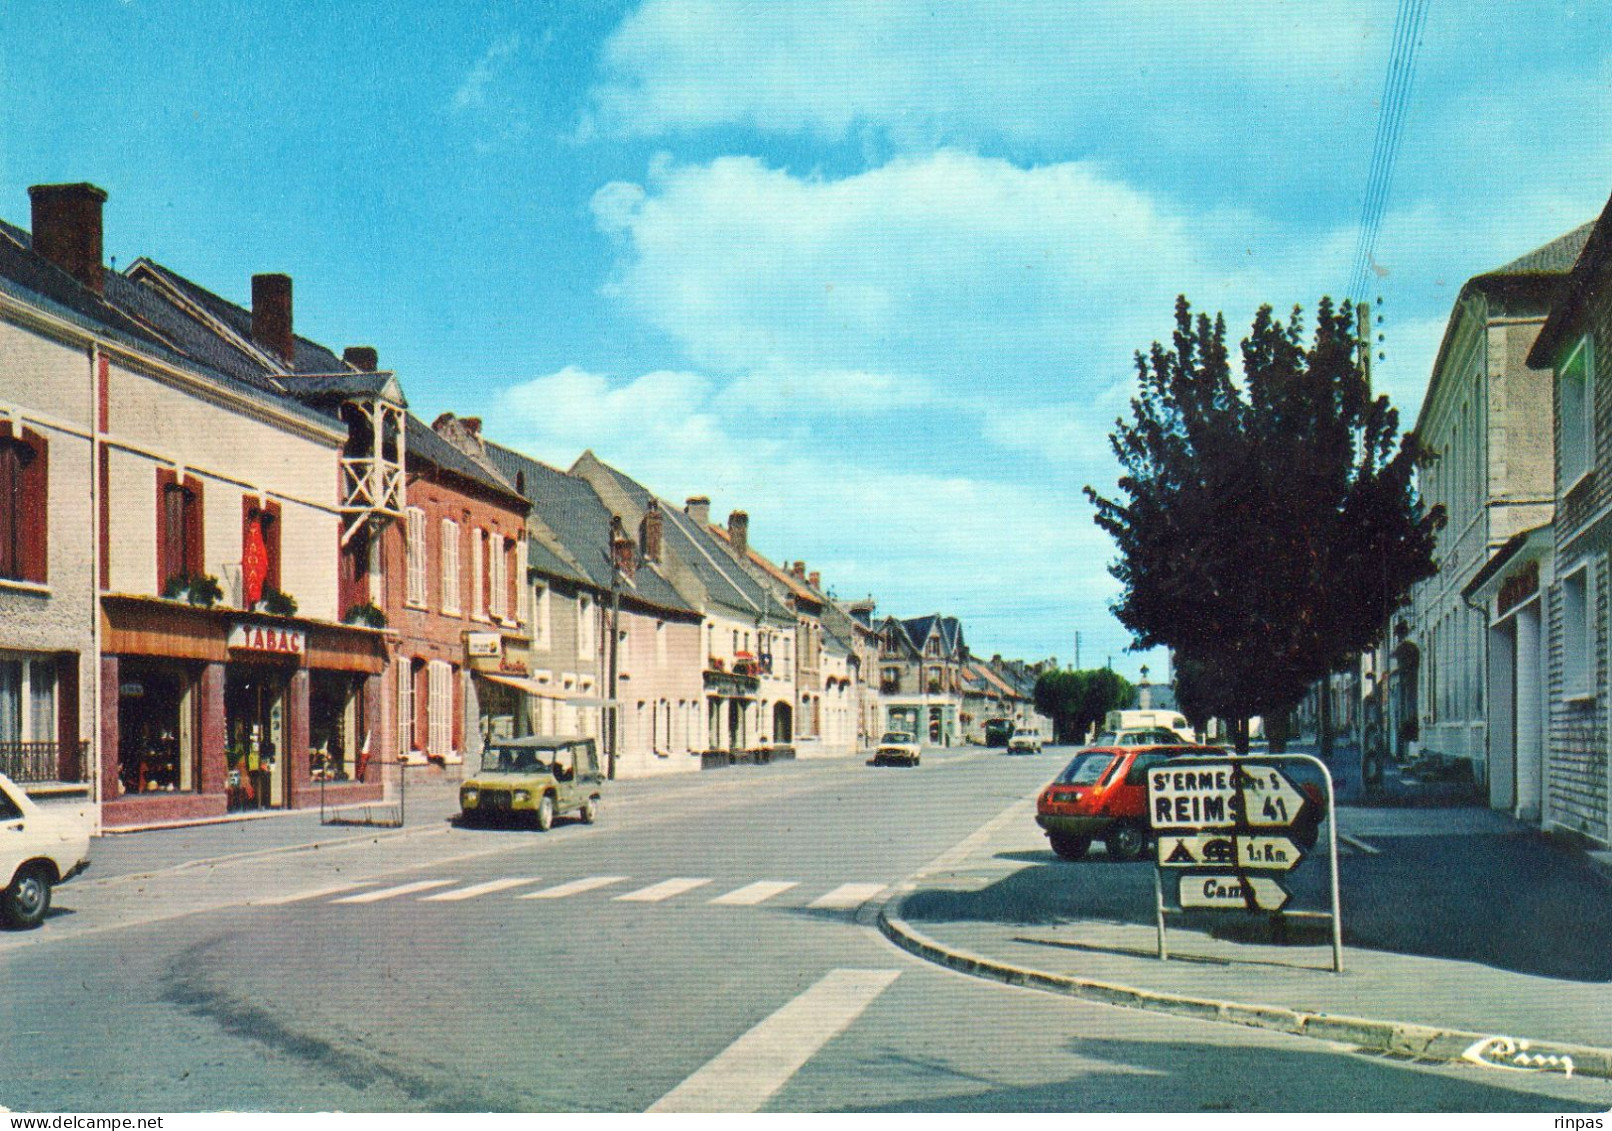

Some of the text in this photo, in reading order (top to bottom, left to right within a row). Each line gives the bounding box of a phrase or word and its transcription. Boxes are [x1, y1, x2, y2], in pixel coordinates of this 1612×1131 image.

[243, 625, 300, 652] TABAC
[1262, 796, 1288, 822] 41
[1203, 879, 1256, 899] Cam
